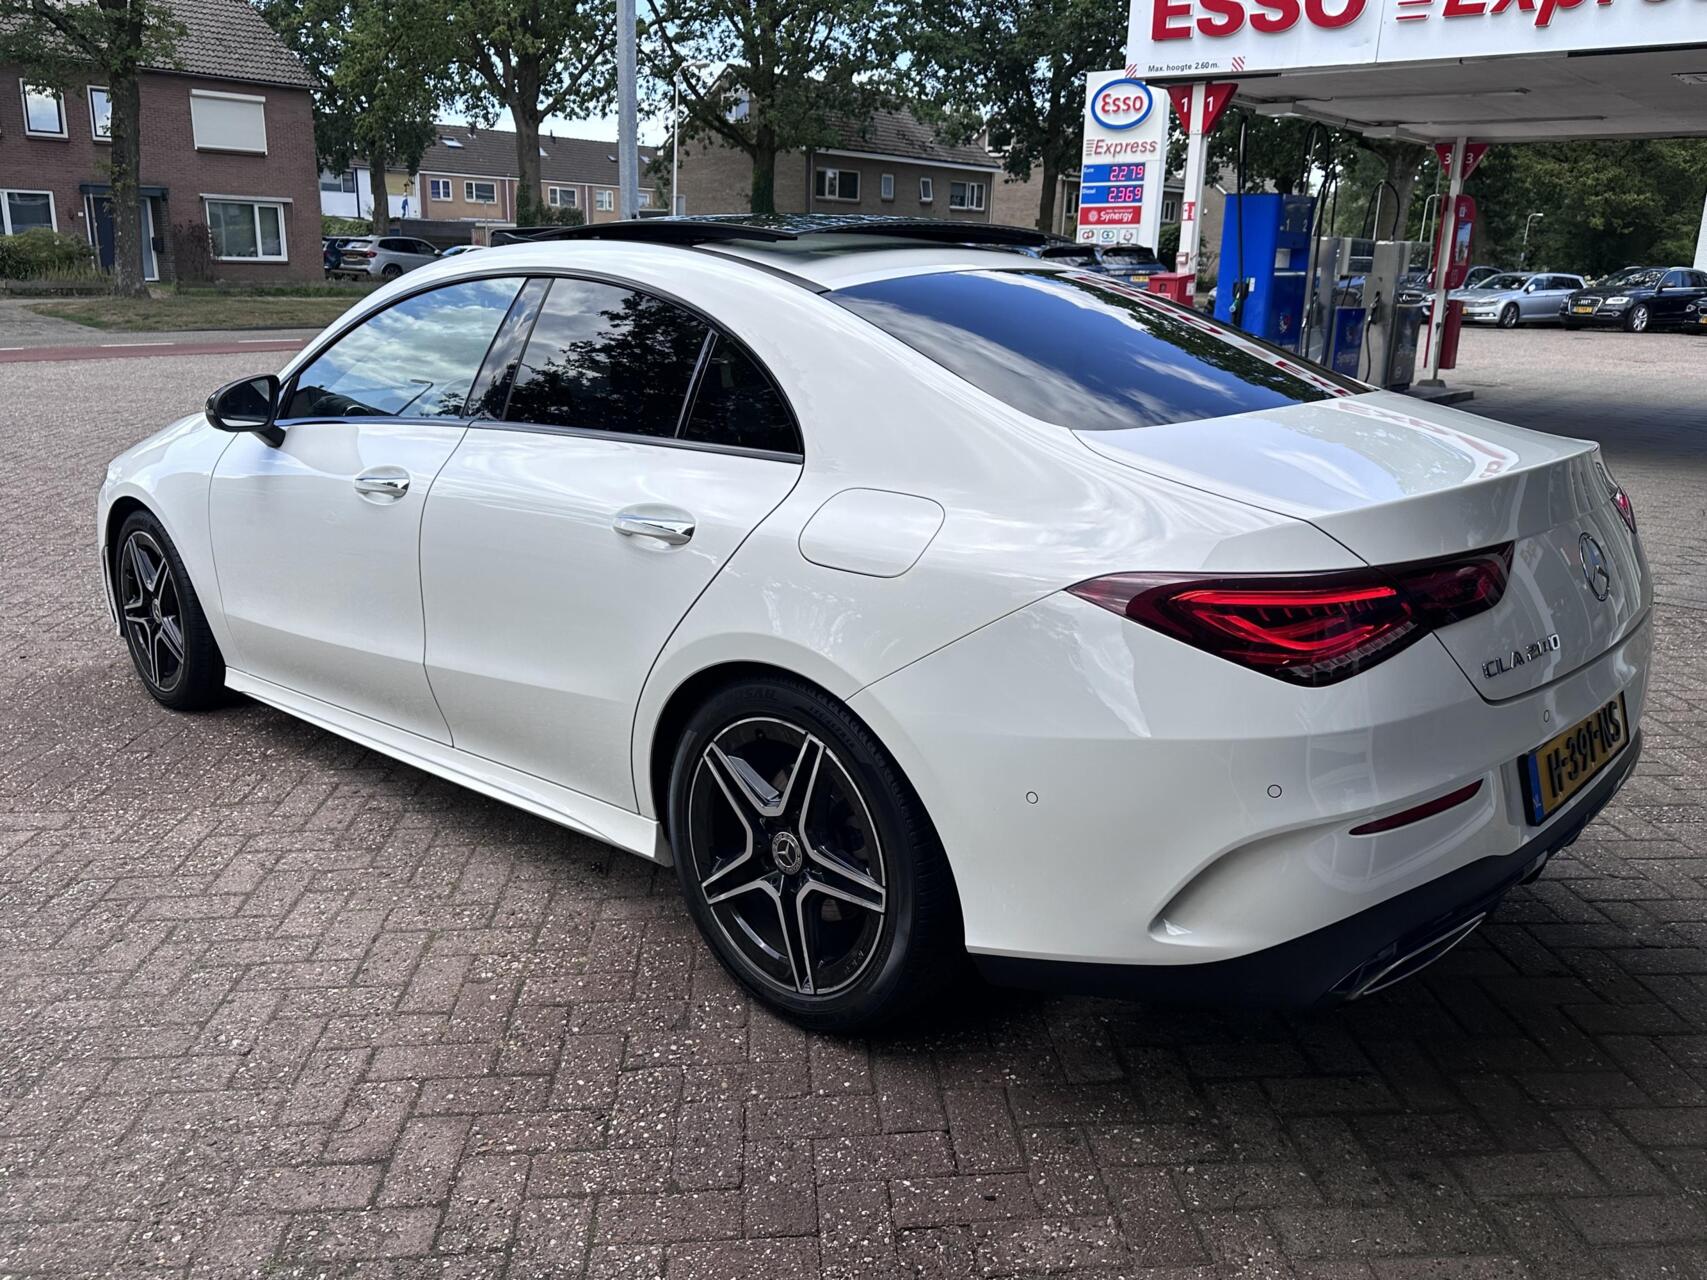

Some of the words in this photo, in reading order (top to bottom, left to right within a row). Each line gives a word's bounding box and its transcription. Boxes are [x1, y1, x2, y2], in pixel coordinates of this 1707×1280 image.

[1148, 65, 1165, 73] Max.
[1166, 63, 1192, 72] hoogte
[1194, 62, 1209, 70] 2.60
[1101, 93, 1143, 113] Esso
[1181, 97, 1189, 113] 1
[1206, 96, 1214, 112] 1
[1094, 139, 1158, 158] Express
[1444, 153, 1452, 164] 3
[1466, 153, 1474, 164] 3
[1110, 165, 1144, 181] 2.279
[1108, 187, 1142, 202] 2.369
[1100, 211, 1134, 223] Synergy
[1482, 649, 1525, 679] CLA
